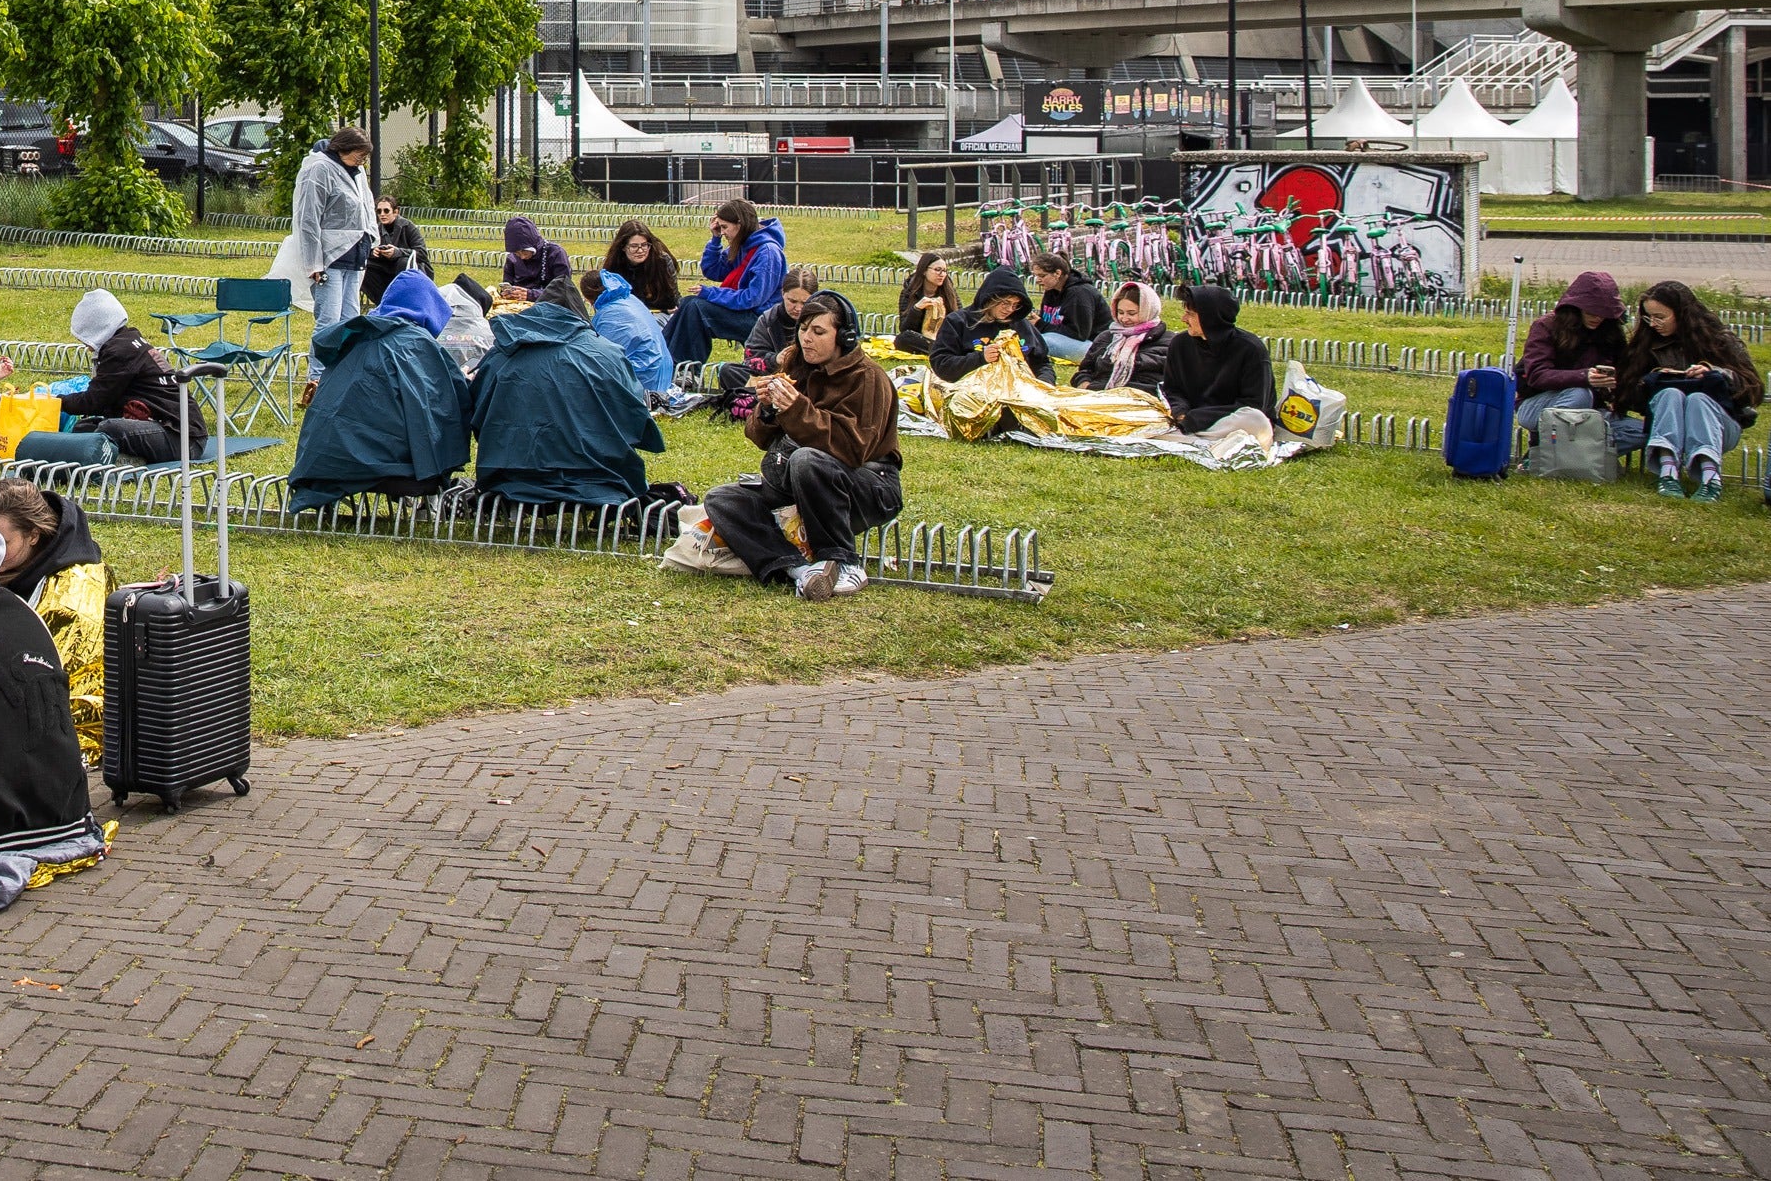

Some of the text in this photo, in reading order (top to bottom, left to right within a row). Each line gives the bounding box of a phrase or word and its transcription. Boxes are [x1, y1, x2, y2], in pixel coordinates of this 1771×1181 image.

[1043, 95, 1081, 105] HARRY
[1041, 104, 1083, 113] STYLES
[960, 142, 988, 151] OFFICIAL
